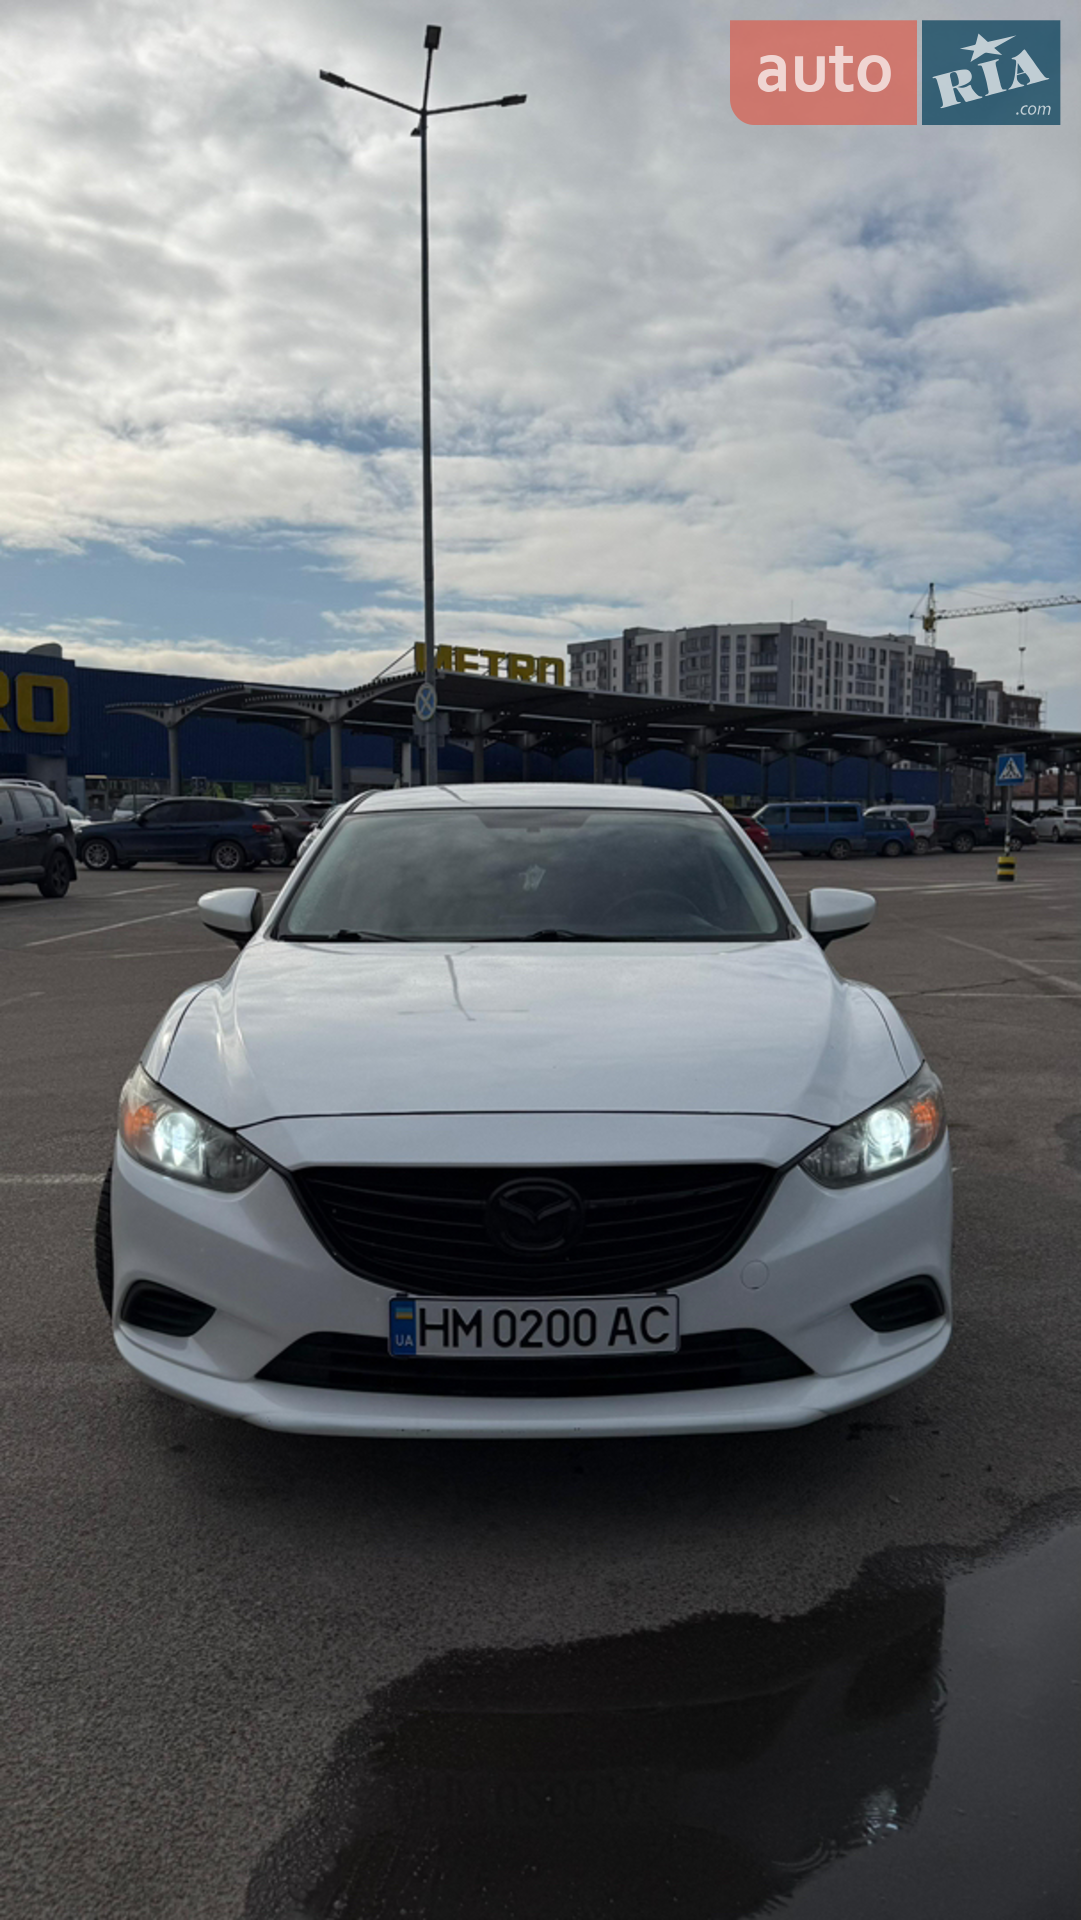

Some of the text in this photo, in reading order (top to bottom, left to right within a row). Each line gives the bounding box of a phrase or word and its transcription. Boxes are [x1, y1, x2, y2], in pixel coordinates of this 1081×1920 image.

[414, 641, 564, 687] METRO
[0, 669, 70, 734] O
[395, 1334, 414, 1347] UA
[419, 1305, 670, 1348] HM 0200 AC
